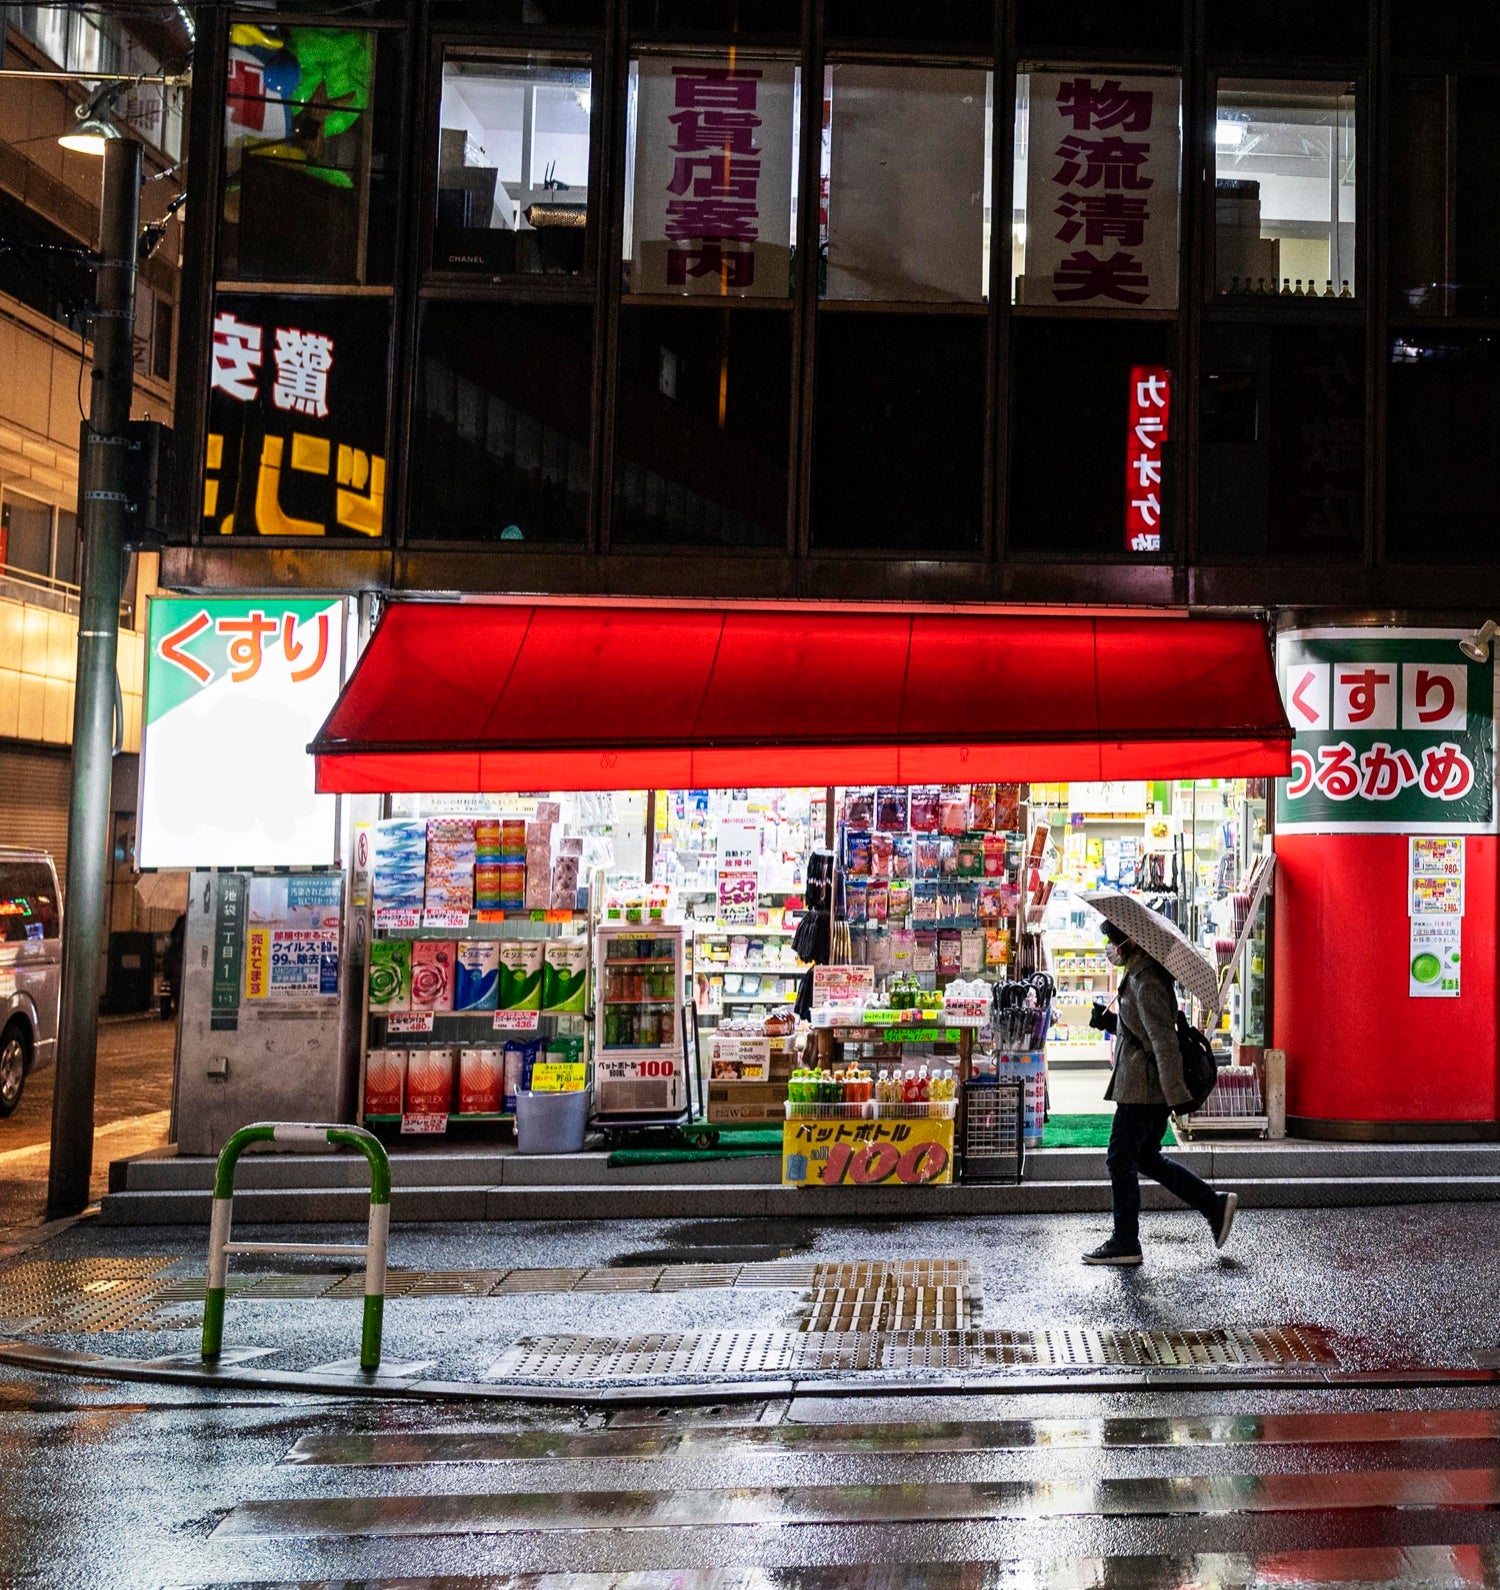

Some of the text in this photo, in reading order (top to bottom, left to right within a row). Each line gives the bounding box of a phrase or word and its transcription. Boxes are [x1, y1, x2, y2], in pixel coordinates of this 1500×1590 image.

[1052, 78, 1154, 305] 物流清关
[448, 255, 485, 264] CHANEL
[160, 611, 330, 684] くすり
[1291, 669, 1456, 724] くすり
[725, 859, 752, 867] 故障中
[1444, 863, 1457, 873] 980
[720, 880, 756, 894] しわ
[274, 931, 337, 940] 部屋中まるごと
[460, 950, 491, 959] エリエール
[503, 950, 536, 959] エリエール
[548, 950, 582, 959] エリエール
[250, 933, 263, 994] 売れてます
[846, 974, 864, 982] 952
[598, 1061, 637, 1070] ペットボトル
[796, 1124, 912, 1143] ペットボトル
[810, 1146, 829, 1161] all
